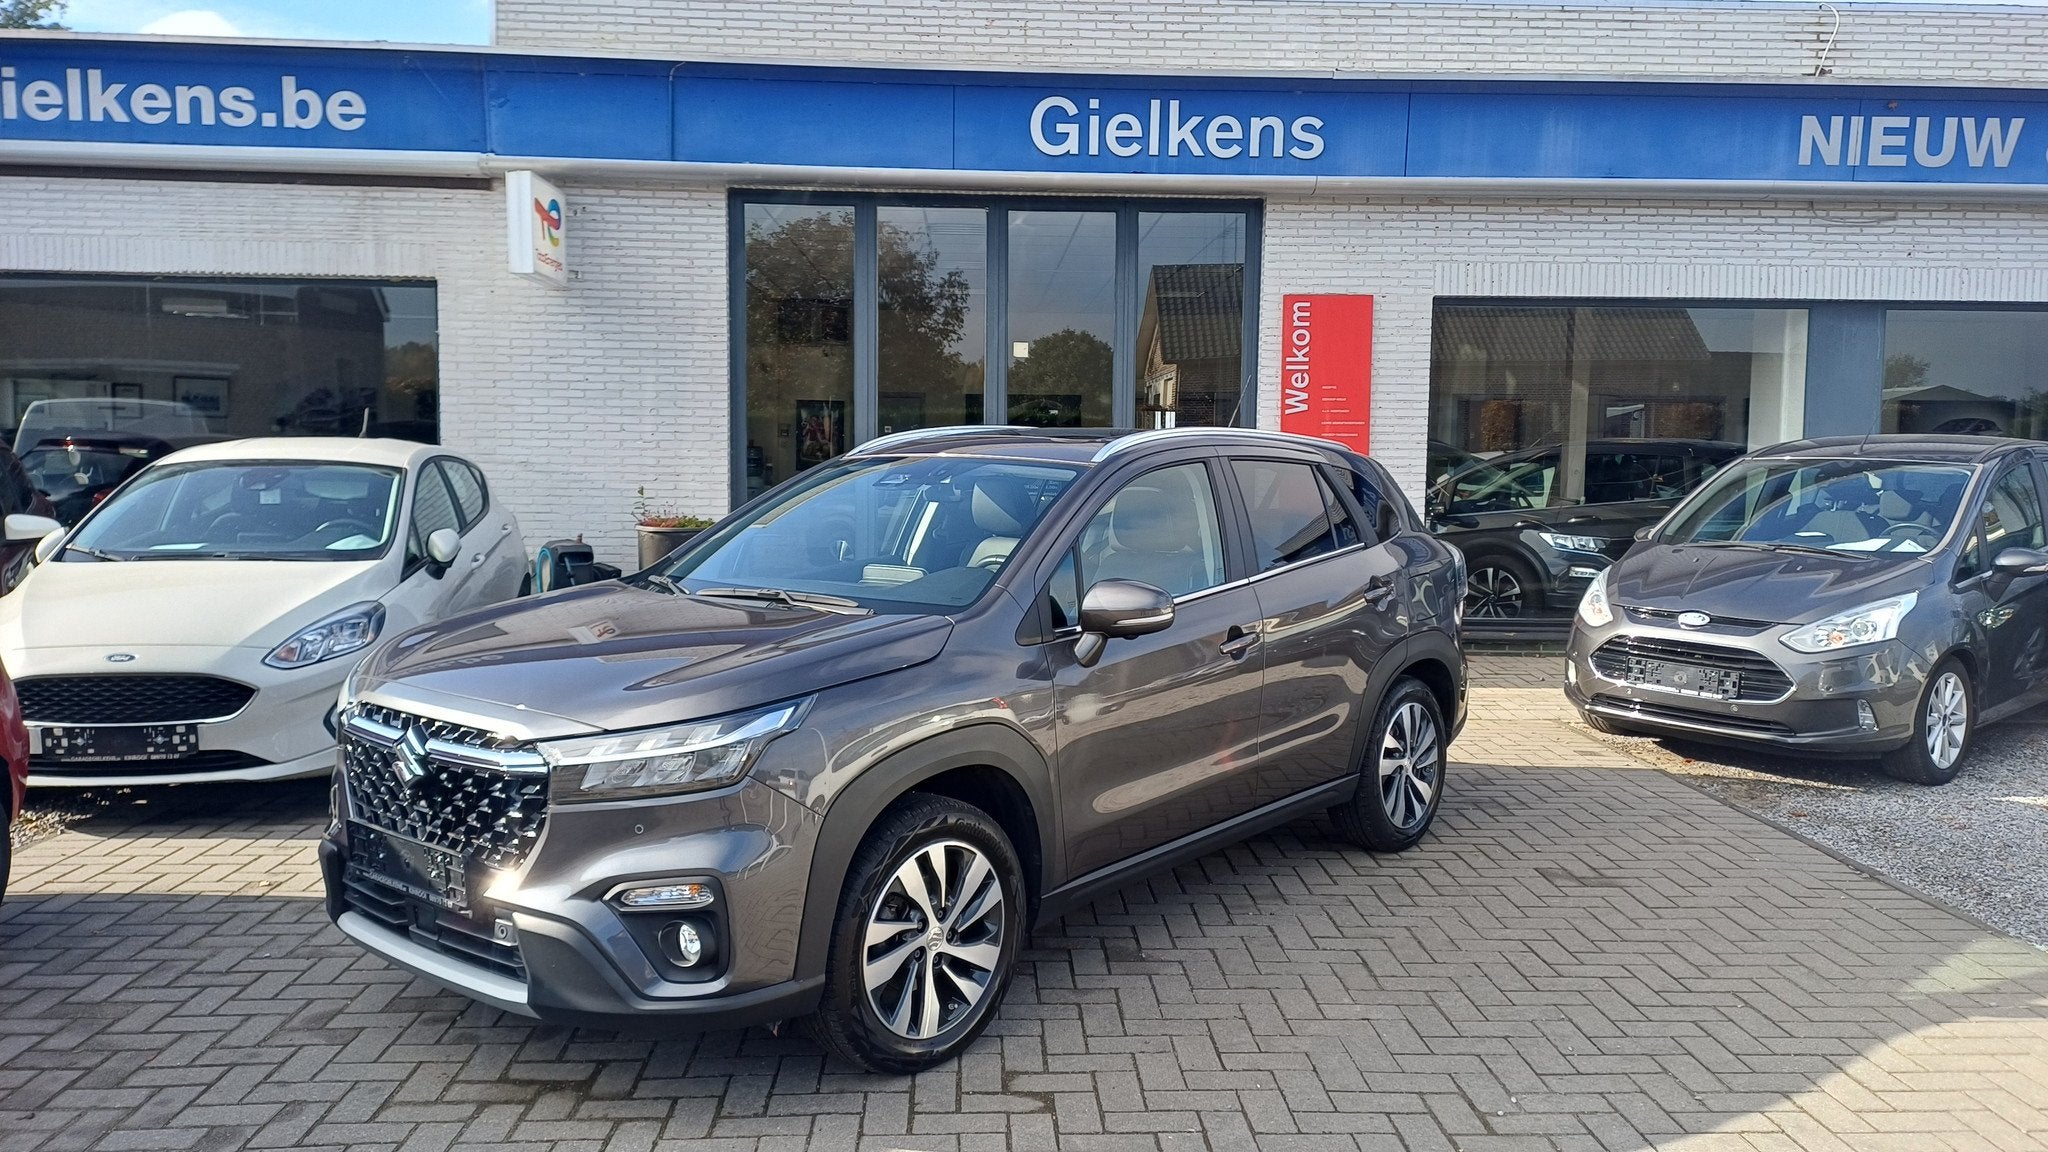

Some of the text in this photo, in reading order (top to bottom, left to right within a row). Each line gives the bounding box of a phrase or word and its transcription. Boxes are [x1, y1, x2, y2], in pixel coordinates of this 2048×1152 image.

[1, 66, 367, 131] ielkens.be
[1030, 96, 1325, 160] Gielkens
[1798, 115, 2026, 168] NIEUW
[1284, 301, 1311, 415] Welkom
